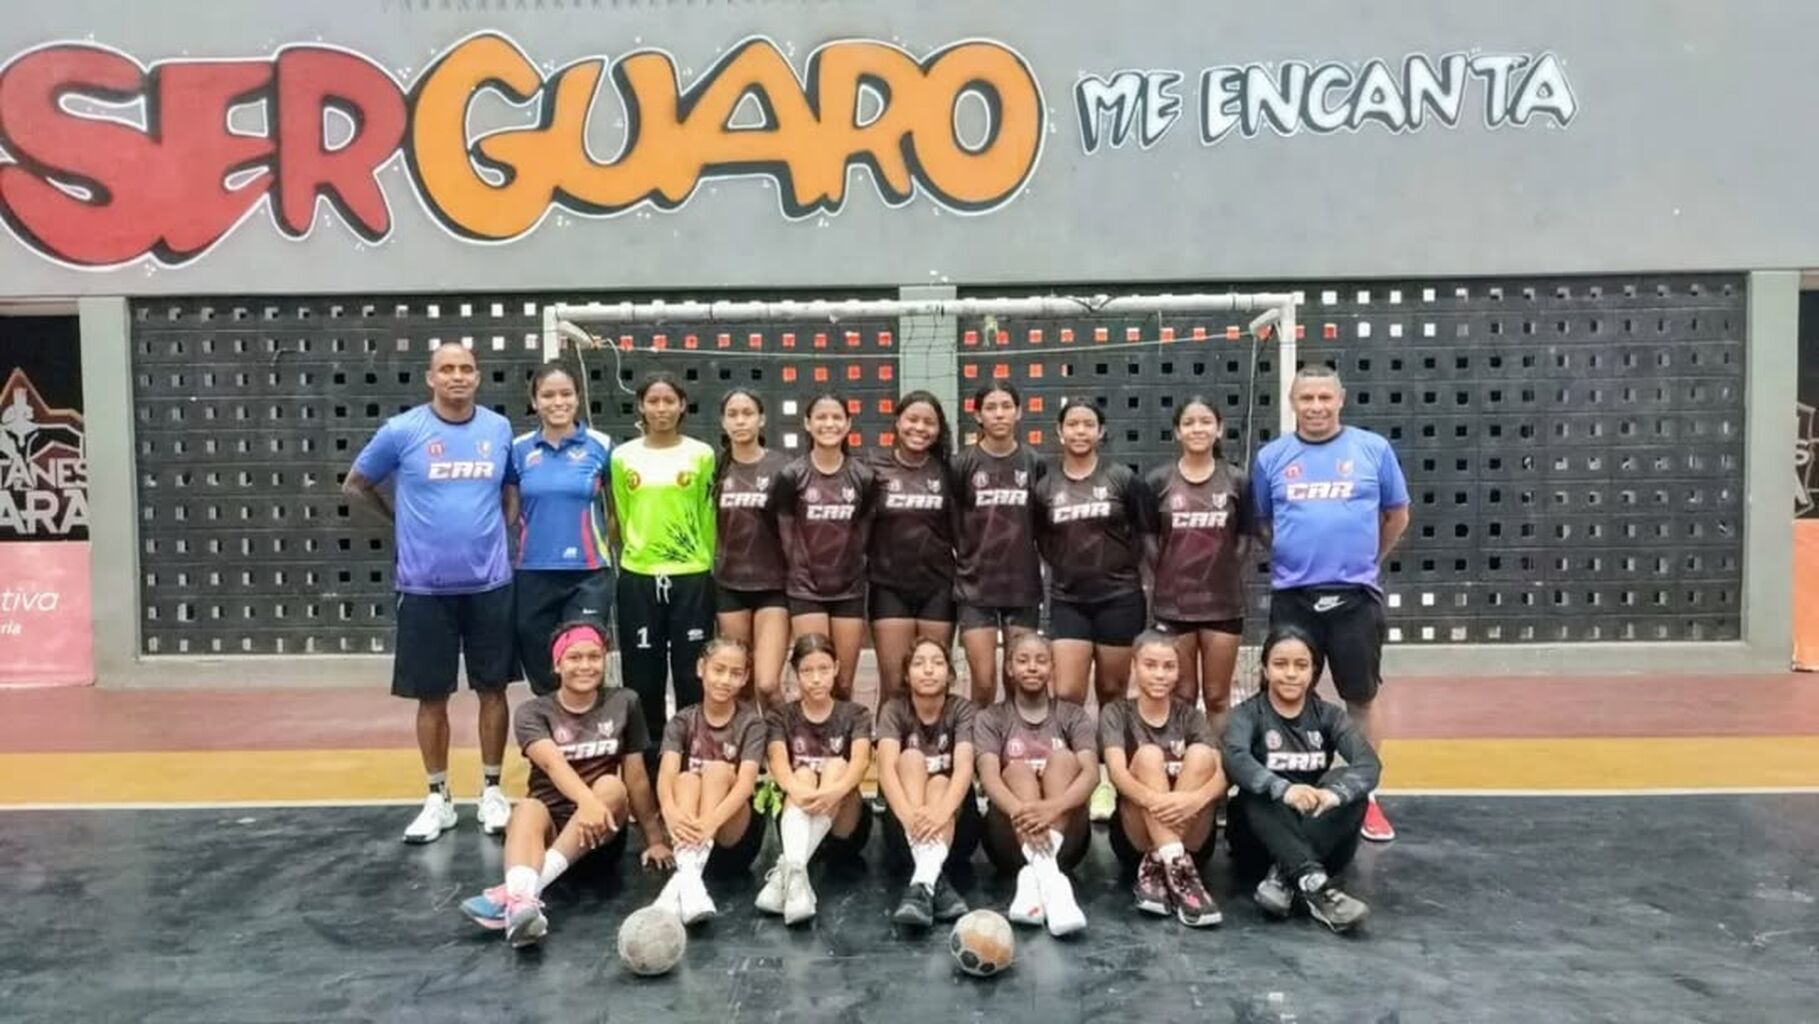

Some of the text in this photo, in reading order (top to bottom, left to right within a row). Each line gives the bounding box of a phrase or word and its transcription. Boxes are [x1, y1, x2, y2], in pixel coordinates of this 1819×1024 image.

[0, 31, 1577, 267] SER GUARO ME ENCANTA
[428, 461, 495, 480] CAR
[719, 491, 768, 508] CAR
[975, 488, 1028, 507] CAR
[1286, 481, 1355, 501] CAR
[885, 493, 943, 509] CAR
[806, 504, 855, 520] CAR
[1053, 501, 1110, 524] CAR
[1171, 511, 1228, 529] CAR
[2, 588, 59, 612] tiva
[637, 626, 652, 648] 1
[1266, 751, 1327, 771] CAR
